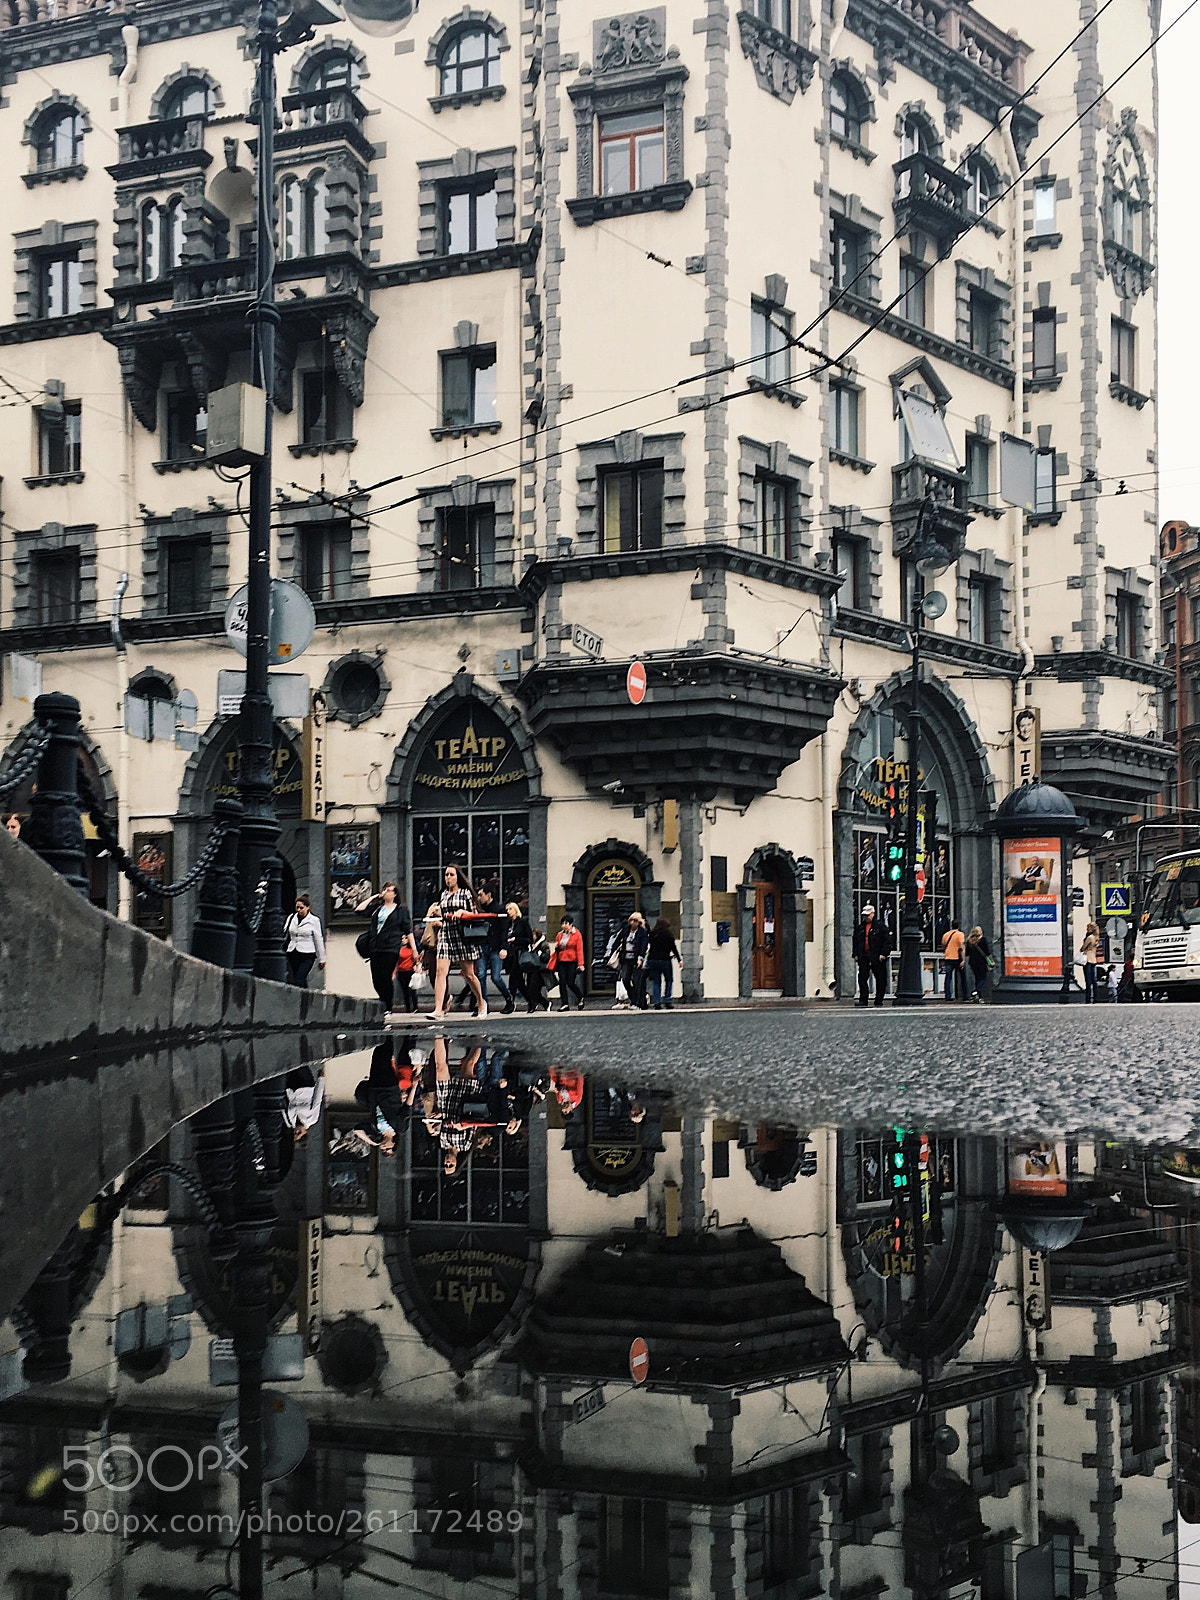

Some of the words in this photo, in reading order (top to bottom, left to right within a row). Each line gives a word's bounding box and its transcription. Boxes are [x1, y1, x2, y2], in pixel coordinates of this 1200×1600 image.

[575, 630, 601, 655] СТОП
[434, 726, 507, 760] ТЕАТР
[314, 737, 323, 816] ТЕАТР
[414, 772, 460, 789] АНДРЕЯ
[460, 768, 527, 789] МИРОНОВА
[446, 762, 494, 775] ИМЕНИ
[1019, 749, 1031, 786] ТЕА
